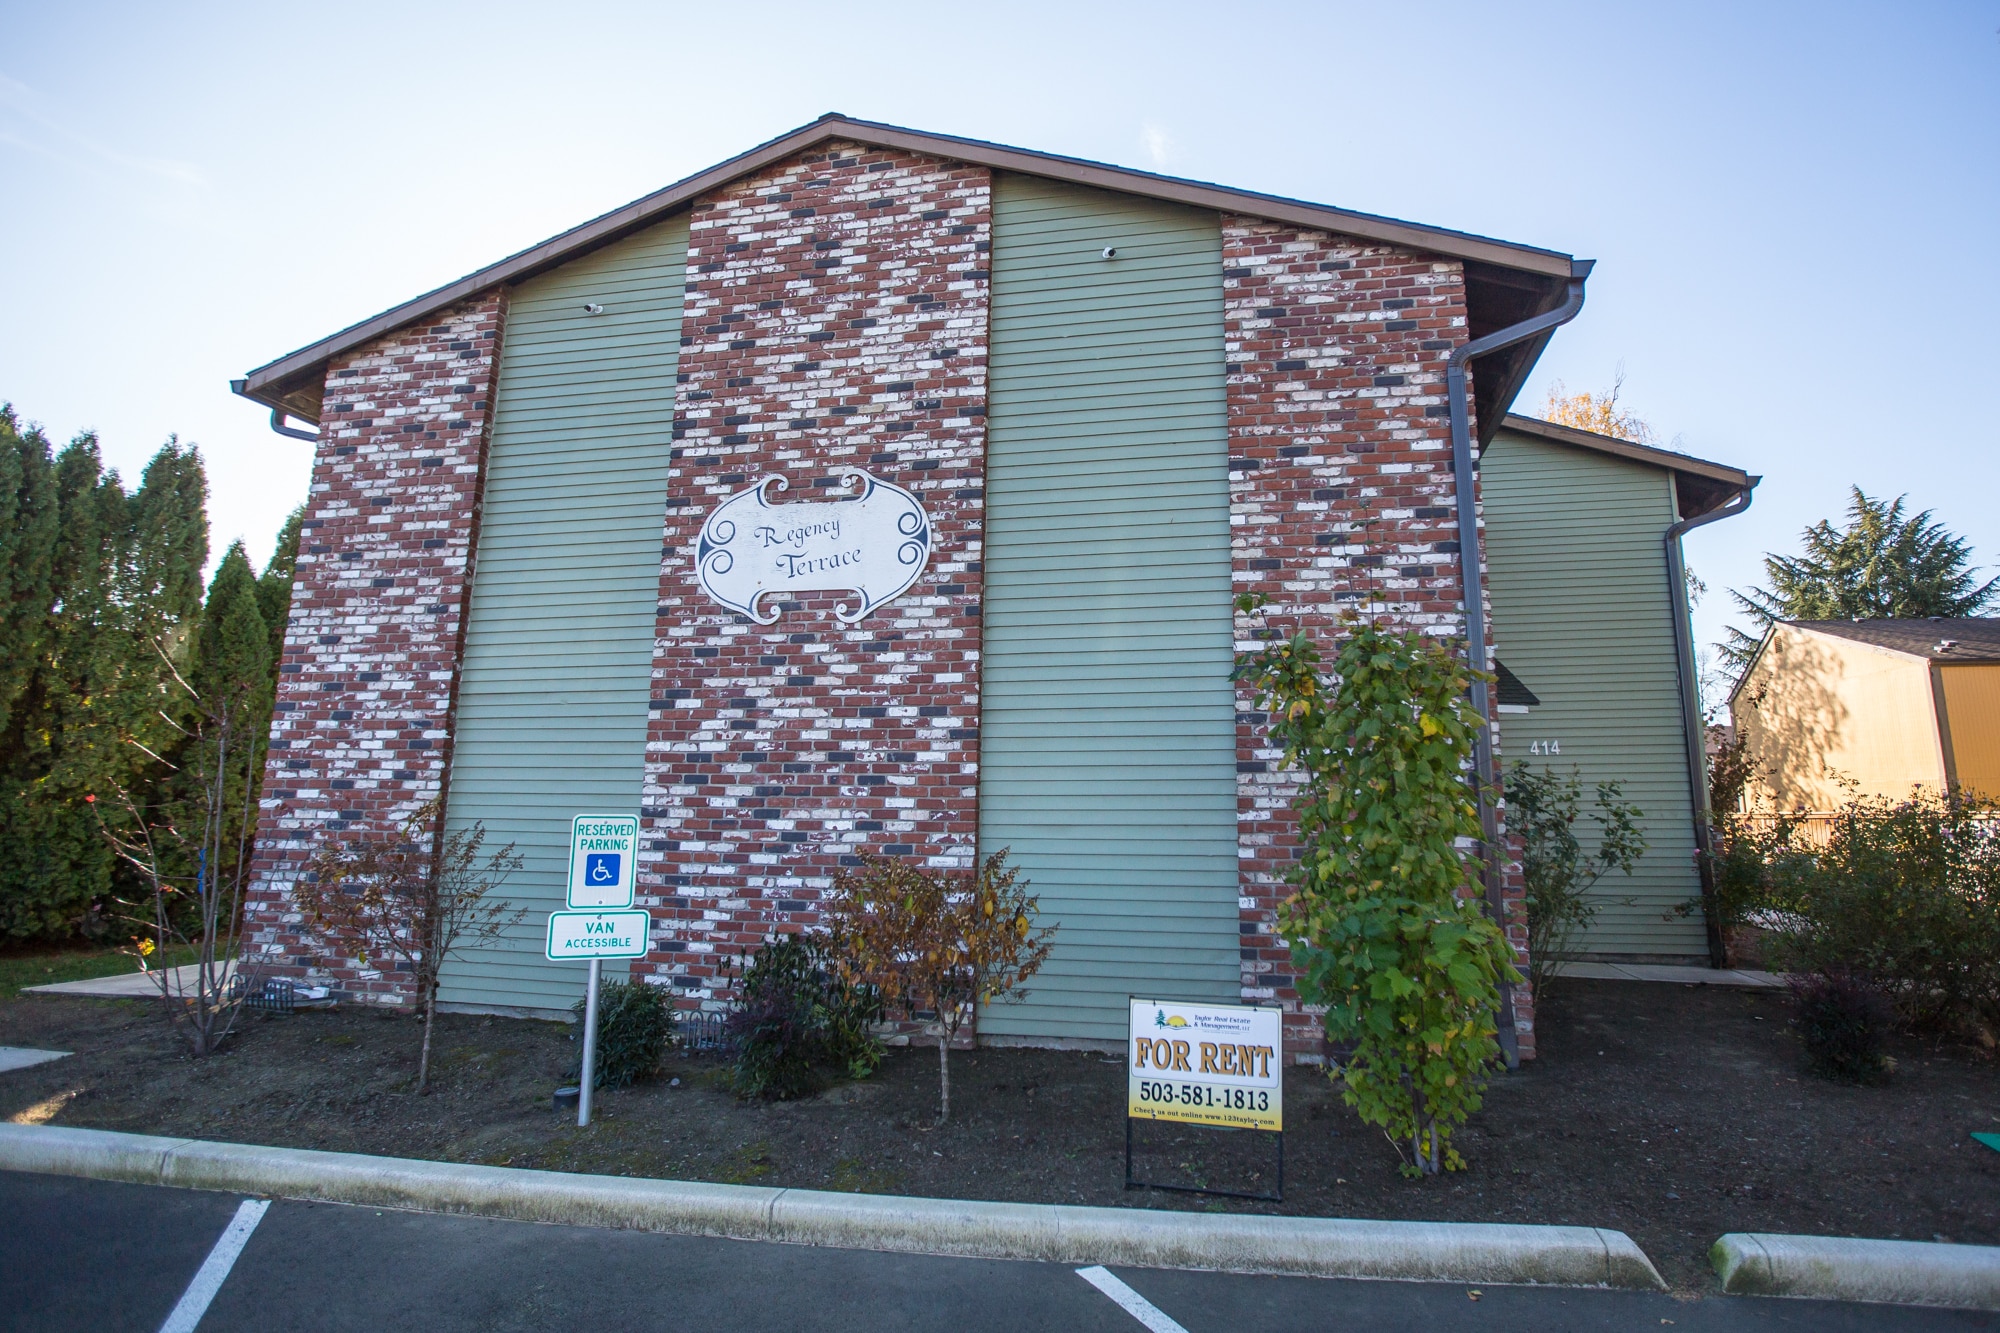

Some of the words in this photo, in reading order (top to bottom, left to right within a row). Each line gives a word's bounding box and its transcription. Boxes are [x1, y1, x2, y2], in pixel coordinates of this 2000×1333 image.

[754, 519, 841, 548] Regency
[776, 549, 862, 578] Terrace
[1530, 740, 1560, 755] 414
[577, 824, 634, 836] RESERVED
[580, 839, 628, 851] PARKING
[586, 921, 615, 934] VAN
[565, 937, 632, 949] ACCESSIBLE
[1194, 1014, 1212, 1022] Taylor
[1135, 1037, 1192, 1072] FOR
[1199, 1042, 1275, 1079] RENT
[1140, 1081, 1269, 1111] 503-581-1813
[1181, 1111, 1203, 1119] online
